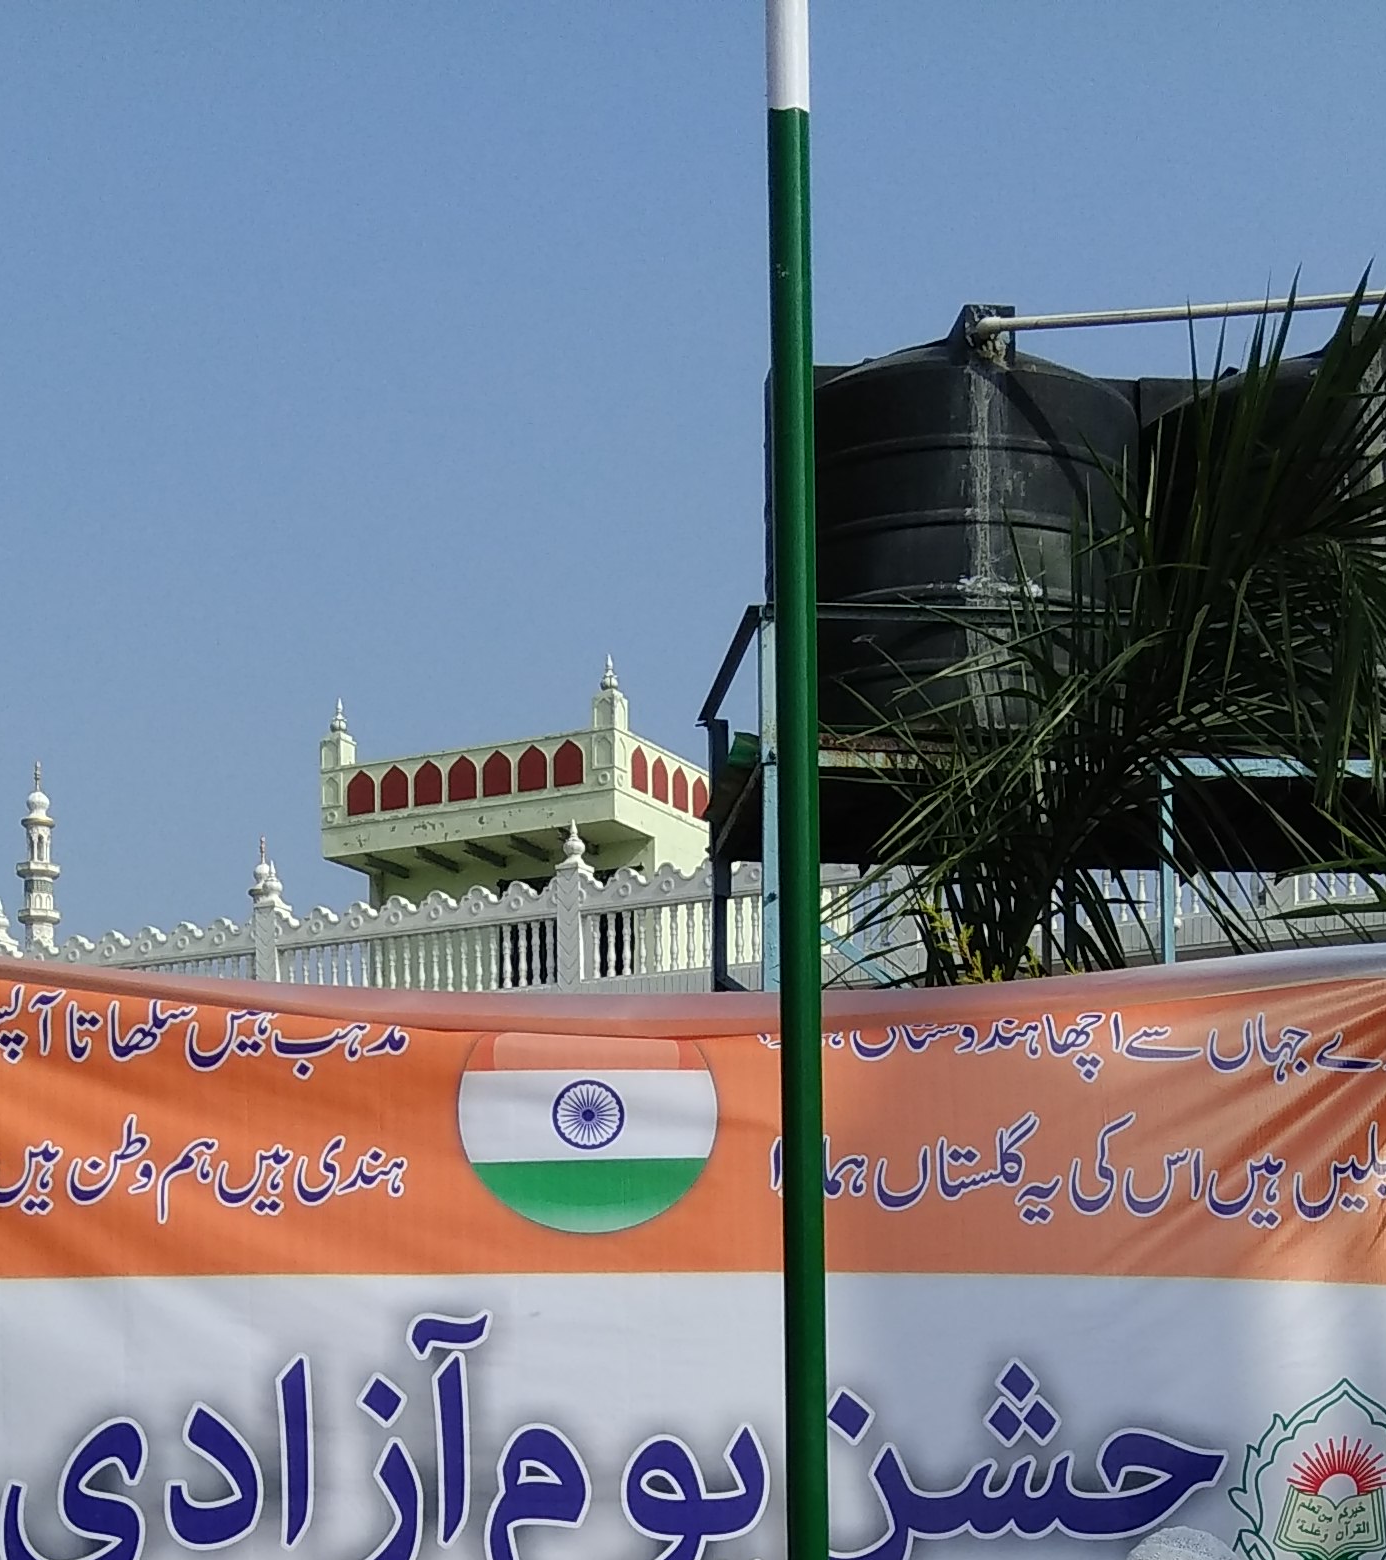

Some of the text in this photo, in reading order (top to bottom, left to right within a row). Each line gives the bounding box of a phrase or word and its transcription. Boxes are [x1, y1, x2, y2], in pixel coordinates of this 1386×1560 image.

[1042, 1011, 1122, 1083] اچھا
[1122, 1025, 1204, 1061] سے
[1207, 1012, 1312, 1084] جہاں
[66, 1113, 156, 1206] وطن
[157, 1138, 219, 1225] ہم
[214, 1143, 293, 1216] ہیں
[293, 1135, 407, 1206] ہندی
[769, 1134, 867, 1200] ہماا
[874, 1111, 1041, 1212] گلستاں
[1068, 1111, 1137, 1216] کی
[1123, 1148, 1203, 1218] اس
[1206, 1153, 1286, 1230] ہیں
[1014, 1176, 1063, 1225] یہ
